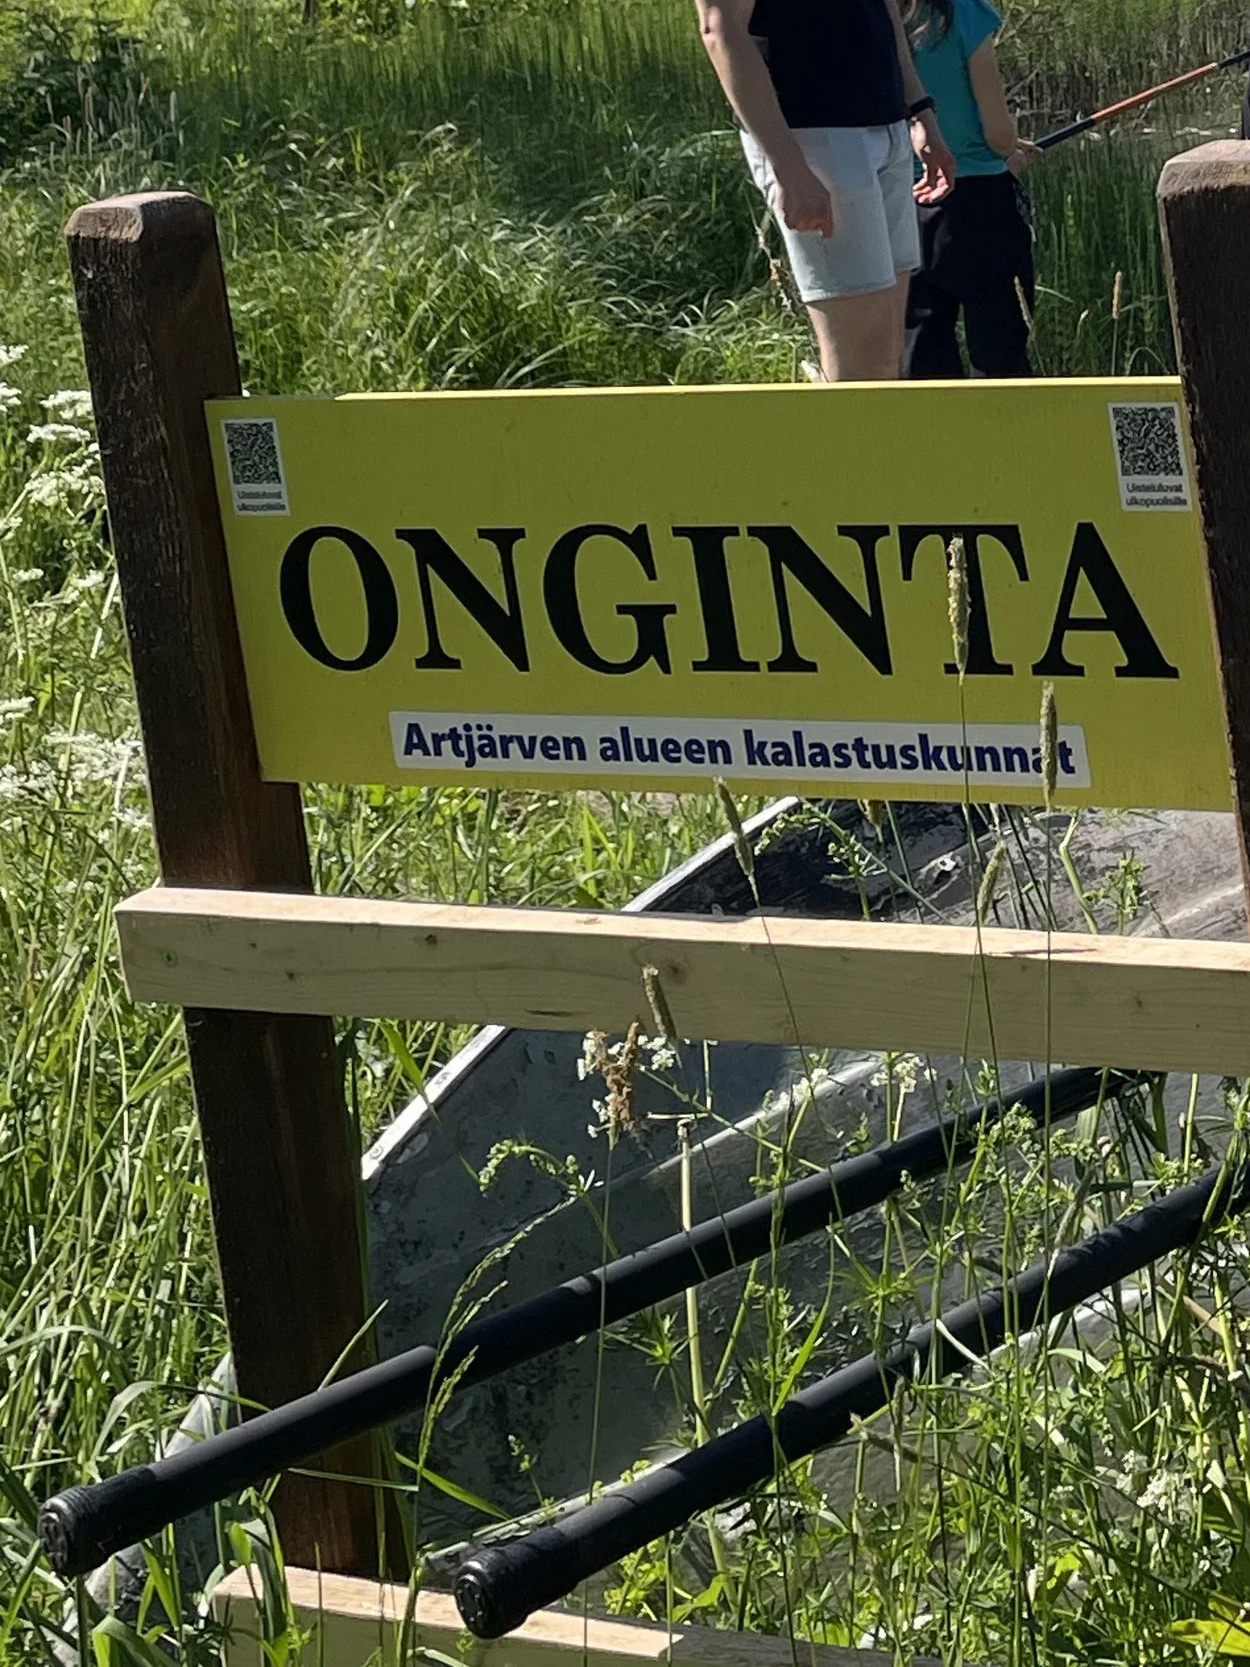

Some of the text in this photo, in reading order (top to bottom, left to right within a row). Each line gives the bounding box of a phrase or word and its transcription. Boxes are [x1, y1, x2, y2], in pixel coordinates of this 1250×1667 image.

[279, 521, 1180, 679] ONGINTA
[403, 722, 587, 768] Artjärven
[600, 726, 733, 765] alueen
